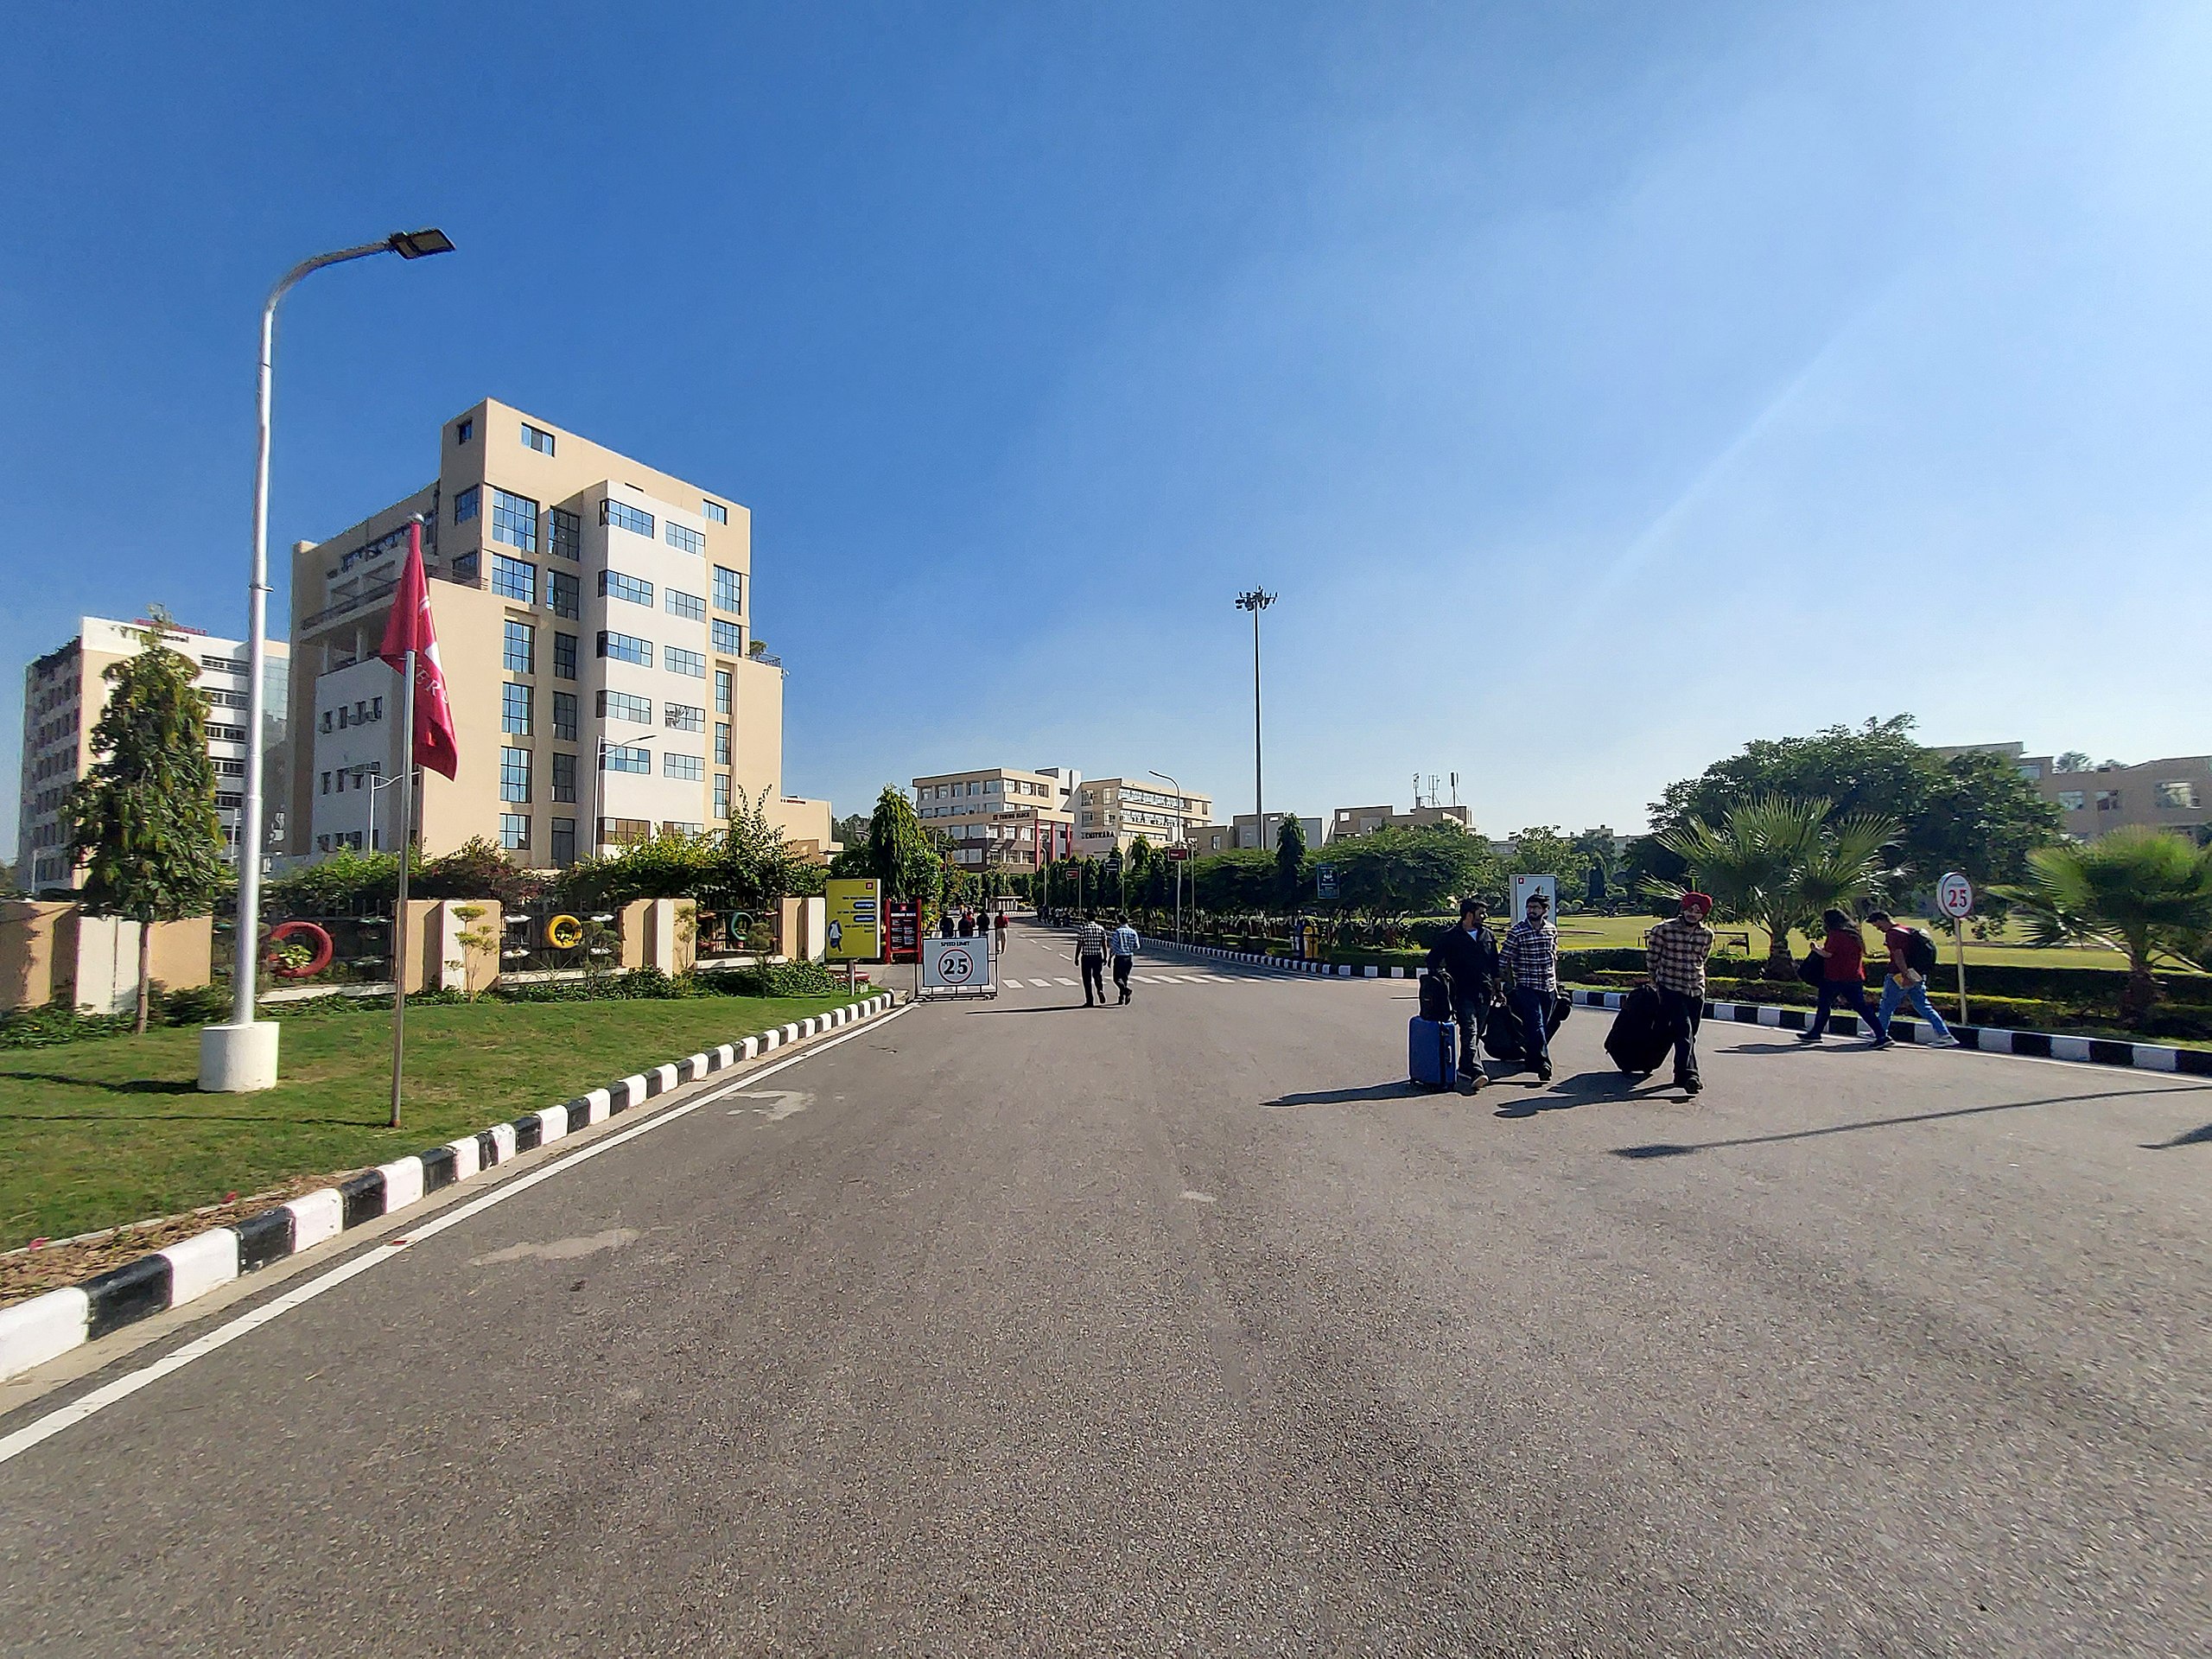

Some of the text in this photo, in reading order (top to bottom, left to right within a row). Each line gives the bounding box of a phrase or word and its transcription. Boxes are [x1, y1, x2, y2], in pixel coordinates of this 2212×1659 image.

[1085, 830, 1116, 839] CHITKARA
[1948, 889, 1967, 907] 25
[944, 957, 969, 976] 25
